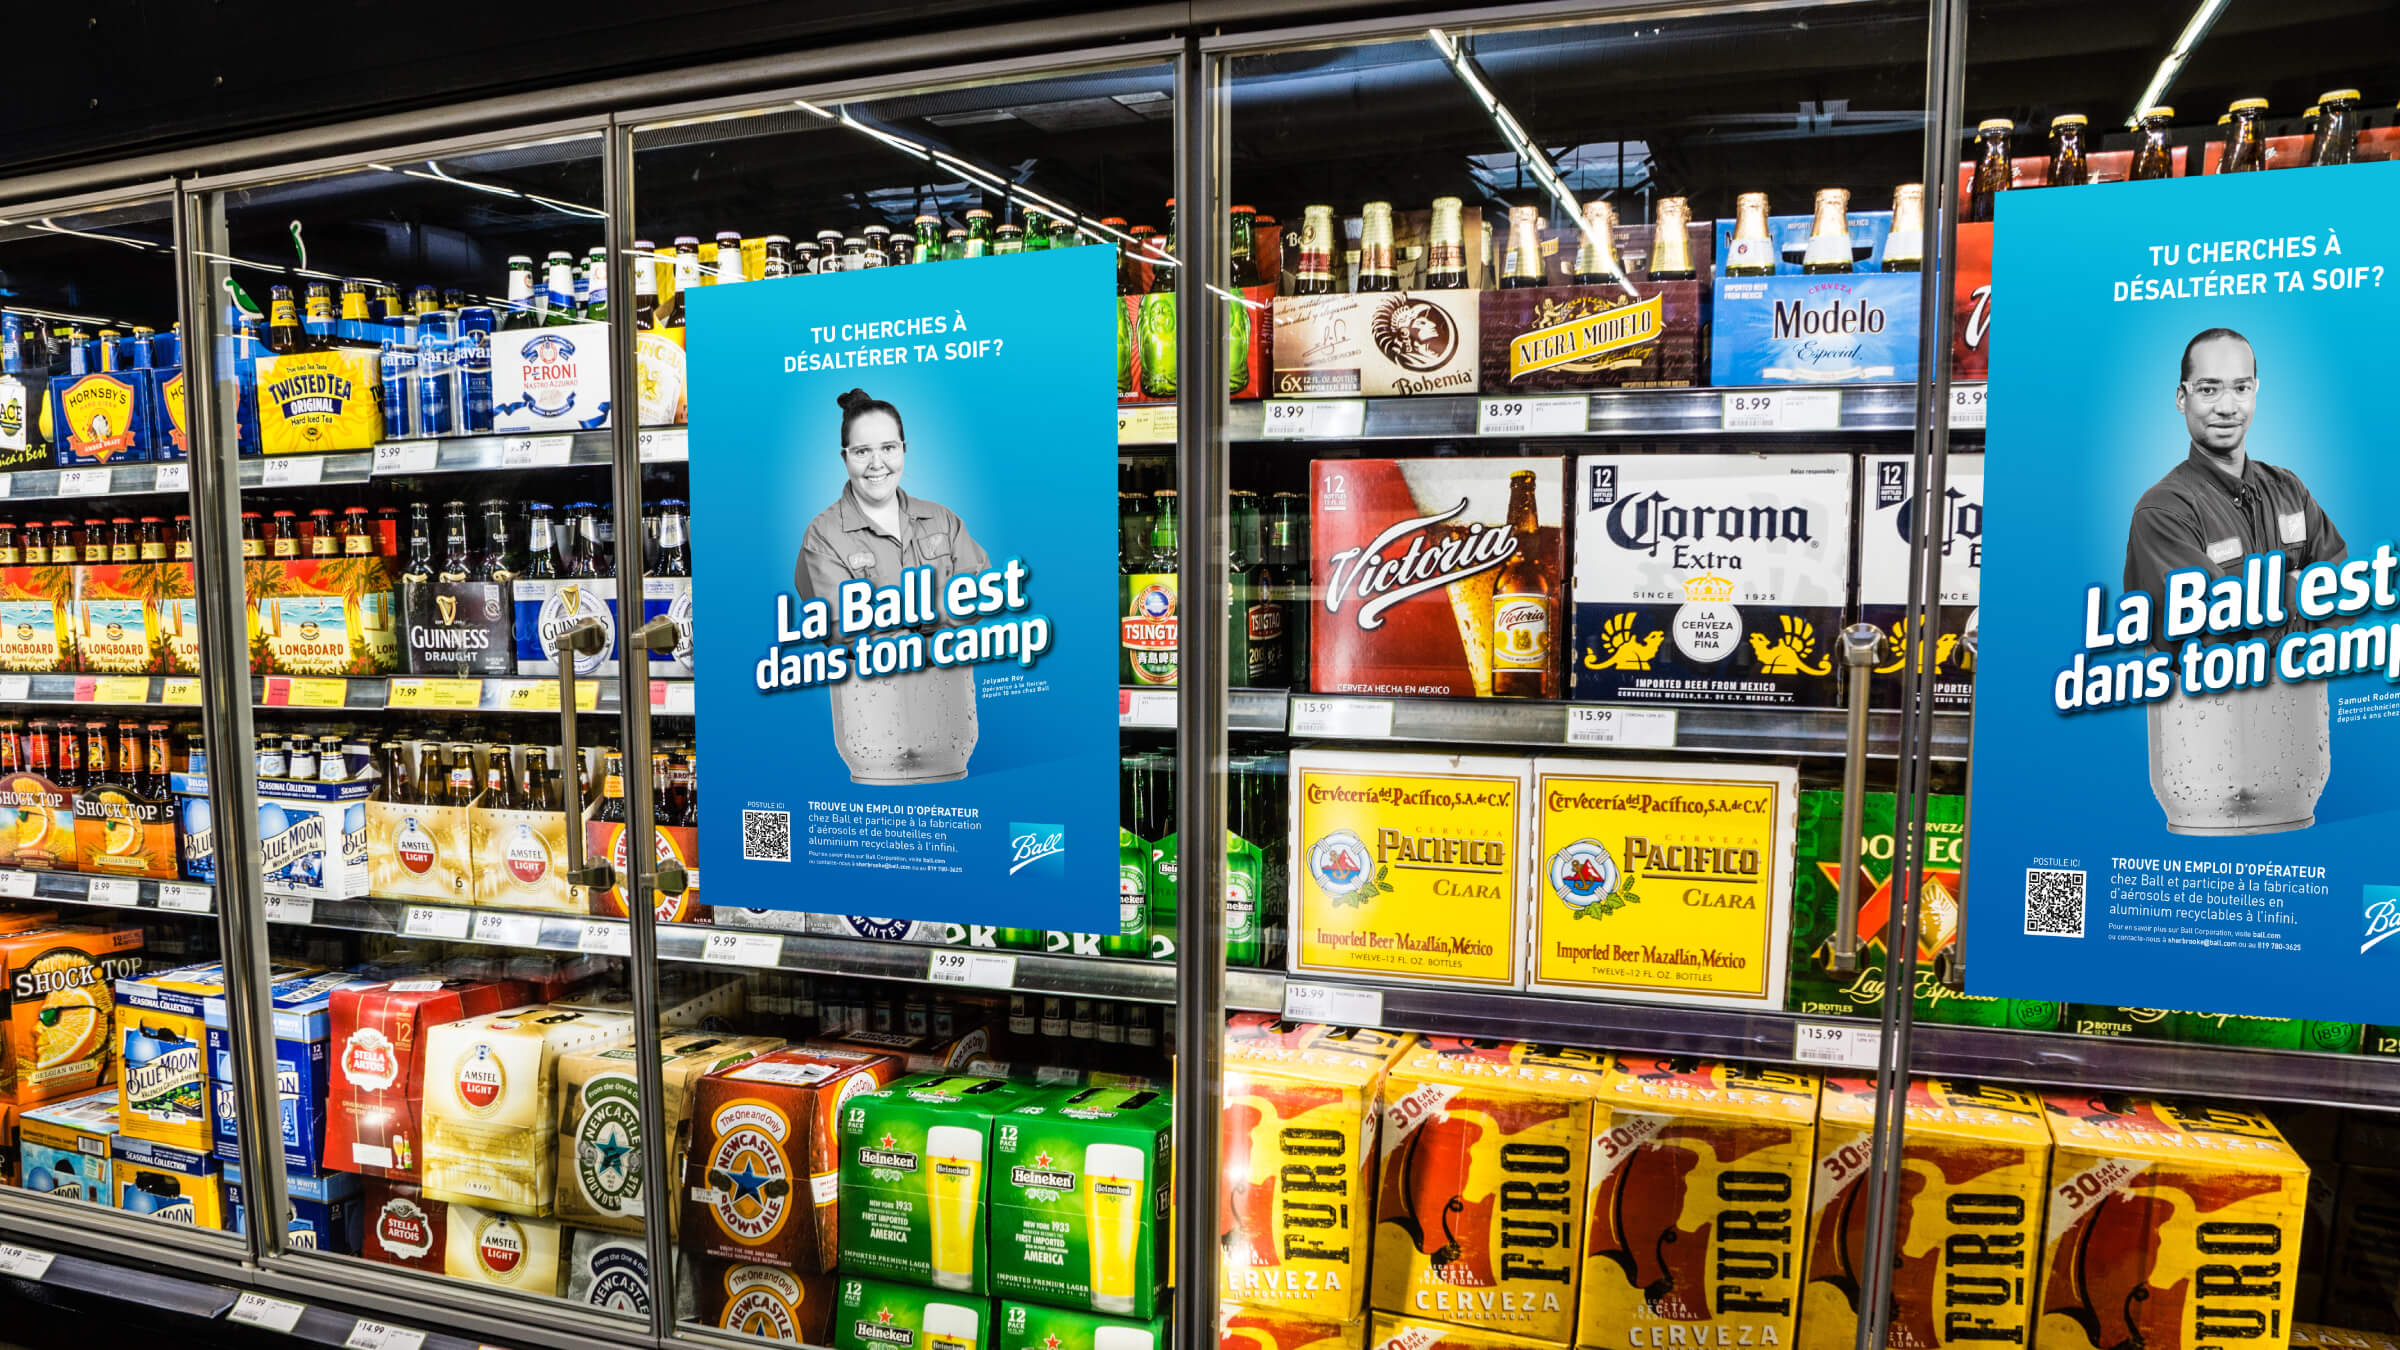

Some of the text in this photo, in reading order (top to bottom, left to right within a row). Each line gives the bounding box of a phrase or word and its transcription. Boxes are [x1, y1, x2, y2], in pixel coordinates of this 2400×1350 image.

[2150, 228, 2341, 266] TU CHERCHES À
[1808, 282, 1852, 295] CERVEZA
[2114, 270, 2267, 301] DÉSALTÉRER
[2274, 271, 2304, 292] TA
[811, 310, 967, 343] TU CHERCHES À
[1773, 298, 1885, 339] Modelo
[1520, 311, 1651, 365] NEGRA MODELO
[784, 346, 907, 372] DÉSALTÉRER
[914, 344, 938, 362] TA
[522, 363, 577, 382] PERONI
[268, 373, 352, 405] TWISTED TEA
[524, 380, 549, 390] NASTRO
[1392, 369, 1473, 396] Bohemia
[68, 385, 127, 409] HORNSBY'S
[290, 398, 333, 415] ORIGINAL
[291, 414, 333, 427] Hard Iced Tea
[1324, 476, 1345, 493] 12
[1594, 468, 1612, 487] 12
[1606, 490, 1812, 557] Corona
[1324, 497, 1518, 630] Victoria
[1673, 544, 1742, 570] Extra
[778, 560, 1025, 642] La Ball est
[1633, 591, 1674, 599] SINCE
[2086, 545, 2398, 648] La Ball est
[1682, 621, 1734, 630] CERVEZA
[1701, 612, 1715, 620] LA
[411, 626, 488, 650] GUINNESS
[1125, 623, 1177, 640] TSINGTA
[1695, 631, 1719, 639] MAS
[89, 643, 144, 656] LONGBOARD
[279, 643, 344, 656] LONGBOARD
[757, 617, 1047, 688] dans ton camp
[1695, 640, 1720, 649] FINA
[424, 652, 478, 662] DRAUGHT
[1636, 678, 1776, 691] IMPORTED BEER FROM MEXICO
[2055, 653, 2170, 710] dans
[2183, 642, 2266, 691] ton
[1337, 684, 1450, 694] CERVEZA HECHA EN MEXICO
[76, 799, 158, 820] SHOCK TOP
[289, 821, 322, 849] MOON
[401, 841, 432, 851] AMSTEL
[1010, 833, 1064, 875] Ball
[1378, 828, 1505, 865] PACIFICO
[406, 853, 428, 863] LIGHT
[2033, 857, 2080, 867] POSTULE ICI
[2112, 858, 2325, 878] TROUVE UN EMPLOI D'OPÉRATEUR
[1433, 879, 1501, 899] CLARA
[2111, 874, 2328, 895] chez Ball et participe à la fabrication
[2111, 888, 2283, 907] d'aérosols et de bouteilles en
[2110, 904, 2172, 917] aluminium
[2177, 907, 2243, 922] recyclables
[2247, 911, 2252, 921] à
[852, 915, 906, 938] WINTER
[2154, 925, 2166, 933] plus
[2253, 931, 2280, 939] ball.com
[1317, 928, 1366, 949] Imported
[1369, 932, 1394, 950] Beer
[1451, 936, 1493, 956] México
[15, 957, 142, 998] SHOCK TOP
[129, 995, 159, 1010] SEASONAL
[160, 998, 194, 1014] COLLECTION
[2020, 1002, 2050, 1018] 1897
[396, 1022, 411, 1040] 12
[2076, 1020, 2132, 1034] 12 BOTTLES
[354, 1049, 385, 1062] STELLA
[353, 1060, 385, 1072] ARTOIS
[464, 1070, 497, 1082] AMSTEL
[466, 1083, 492, 1095] LIGHT
[1417, 1087, 1434, 1106] CAN
[1420, 1090, 1444, 1111] PACK
[720, 1110, 781, 1134] The One and Only
[849, 1109, 865, 1122] 12
[1388, 1097, 1422, 1131] 30
[848, 1121, 864, 1129] PACK
[1000, 1127, 1018, 1140] 12
[1000, 1139, 1016, 1147] PACK
[719, 1134, 781, 1175] NEWCASTLE
[861, 1151, 915, 1169] Heineken
[1015, 1171, 1072, 1187] Heineken
[1279, 1128, 1351, 1265] FURO
[1500, 1143, 1571, 1285] FURO
[1716, 1171, 1792, 1317] FURO
[1024, 1250, 1064, 1266] AMERICA
[1944, 1192, 2026, 1346] FURO
[997, 1273, 1031, 1284] IMPORTED
[1033, 1277, 1064, 1289] PREMIUM
[1066, 1284, 1089, 1292] LAGER
[1416, 1290, 1560, 1312] CERVEZA
[1629, 1324, 1779, 1347] CERVEZA
